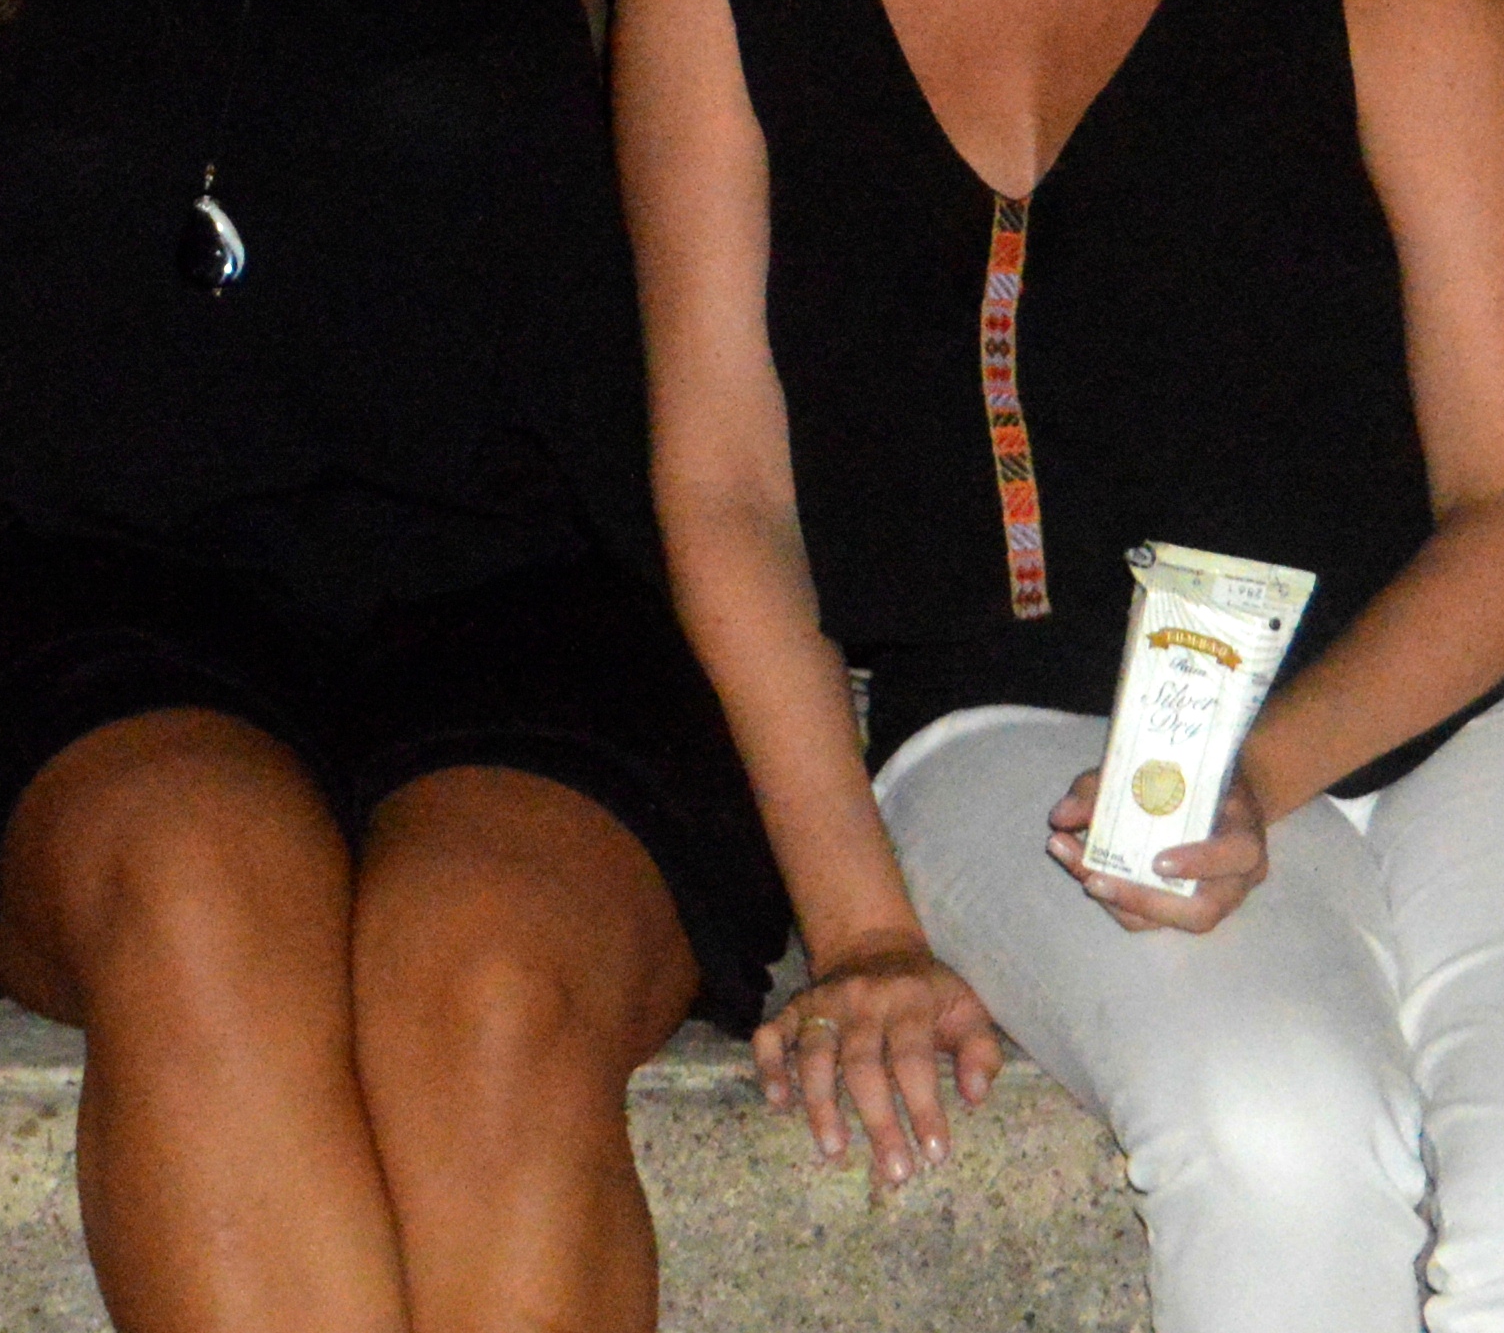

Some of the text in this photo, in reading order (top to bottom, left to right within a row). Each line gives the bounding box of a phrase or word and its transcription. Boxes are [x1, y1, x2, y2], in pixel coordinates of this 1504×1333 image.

[1169, 657, 1207, 677] Rum
[1140, 680, 1219, 711] Silver
[1147, 710, 1203, 746] Dry
